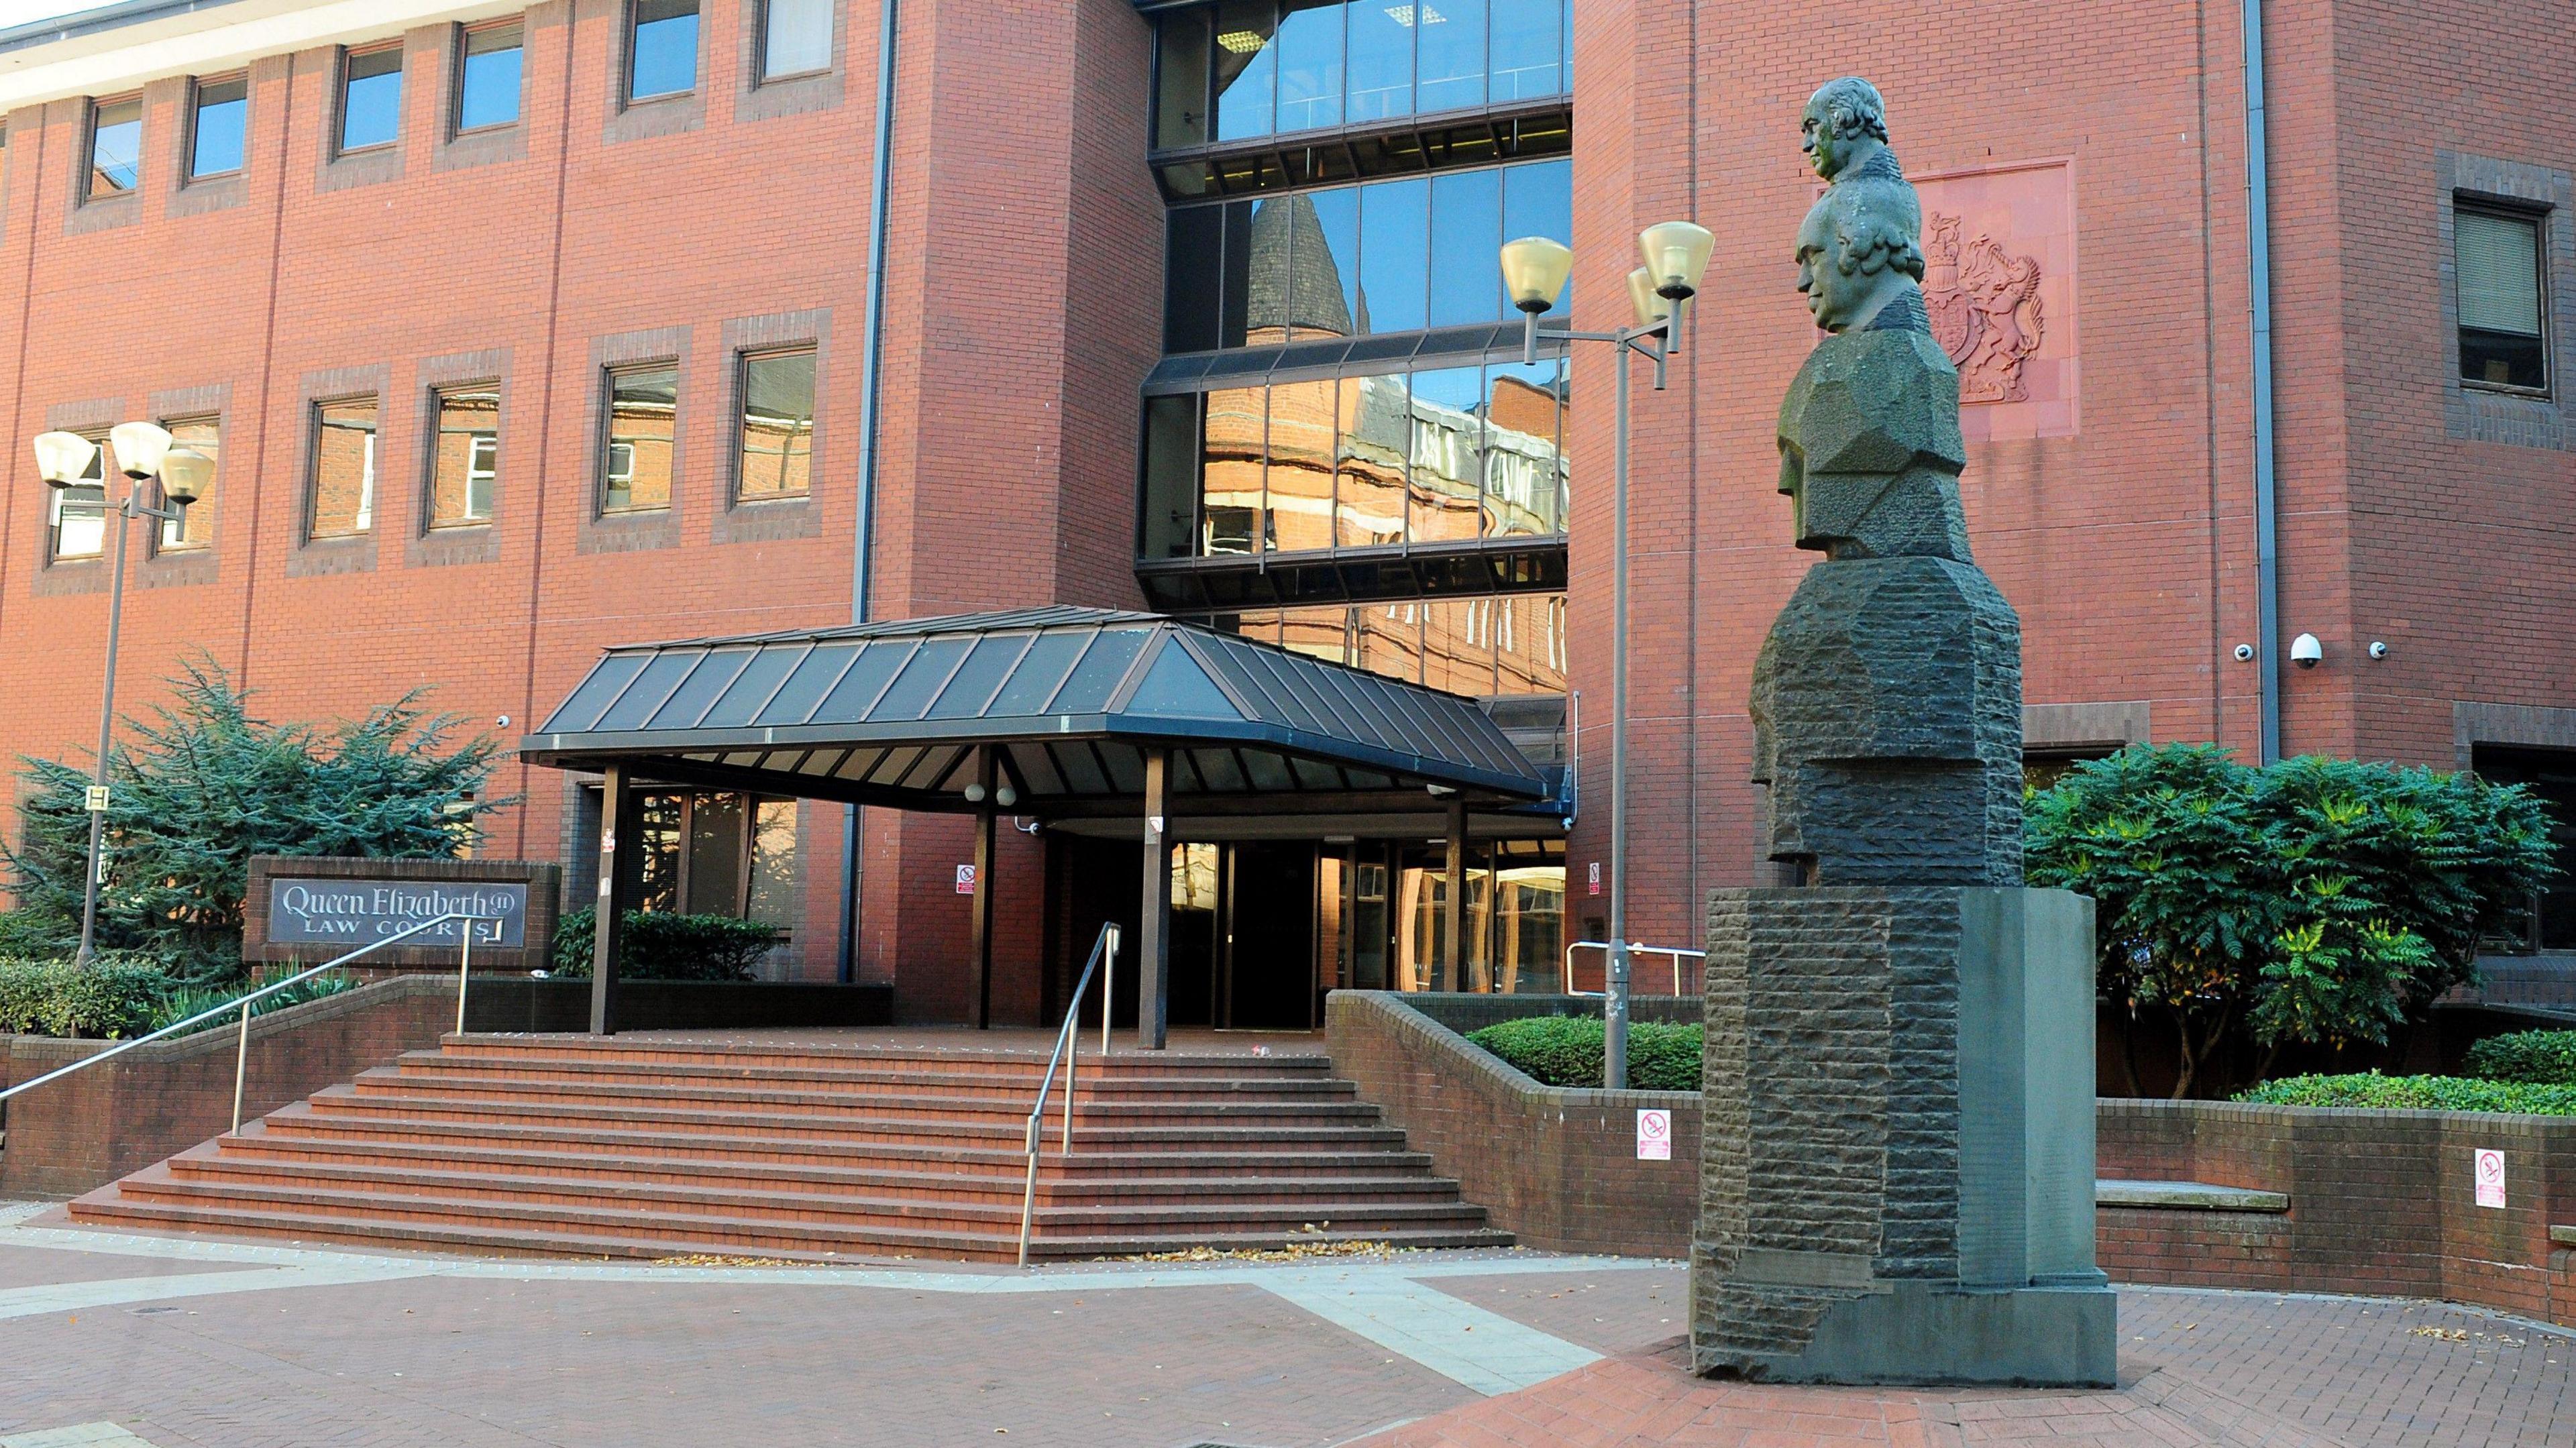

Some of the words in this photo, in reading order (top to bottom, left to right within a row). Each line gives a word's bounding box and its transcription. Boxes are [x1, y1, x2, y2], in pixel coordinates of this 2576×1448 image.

[282, 886, 368, 918] Queen
[371, 888, 486, 920] Elizabeth
[304, 920, 361, 933] LAW
